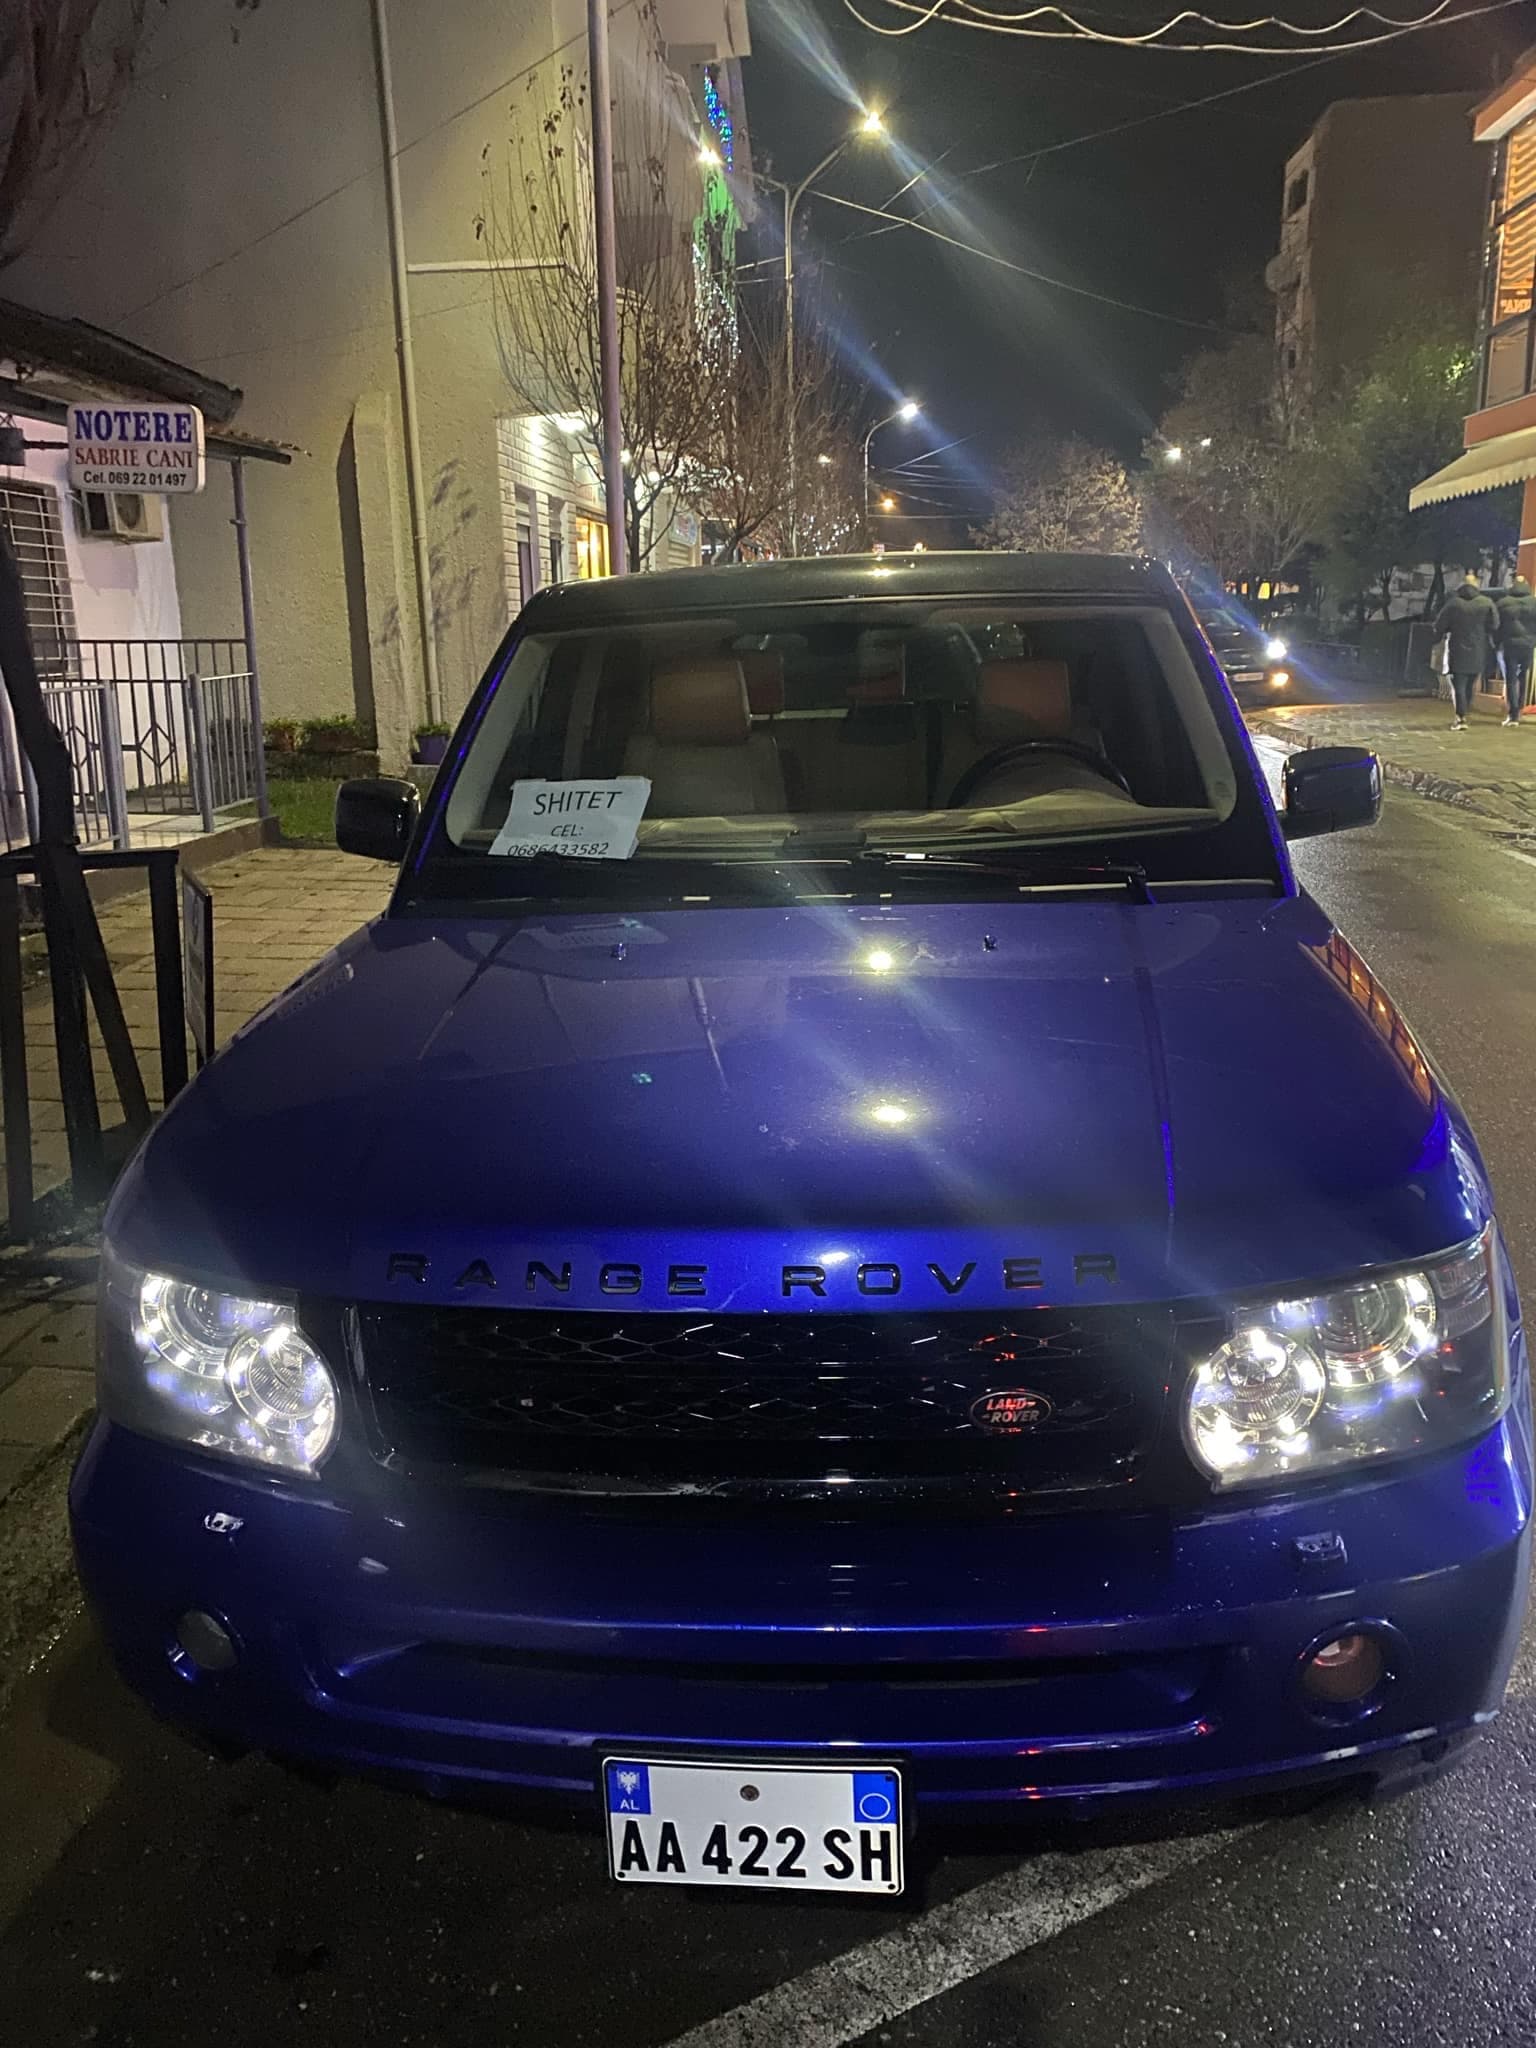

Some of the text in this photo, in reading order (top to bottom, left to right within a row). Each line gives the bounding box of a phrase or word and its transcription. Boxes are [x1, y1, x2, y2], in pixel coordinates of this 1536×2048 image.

[74, 409, 192, 443] NOTERE
[75, 447, 193, 468] SABRIE CANI
[83, 470, 106, 484] Cel.
[108, 471, 130, 485] 069
[533, 790, 623, 816] SHITET
[550, 823, 584, 838] CEL:
[386, 1252, 1119, 1297] RANGE ROVER
[986, 1397, 1027, 1411] LAND
[989, 1410, 1040, 1423] ROVER
[619, 1798, 641, 1811] AL
[619, 1819, 892, 1882] AA 422 SH
